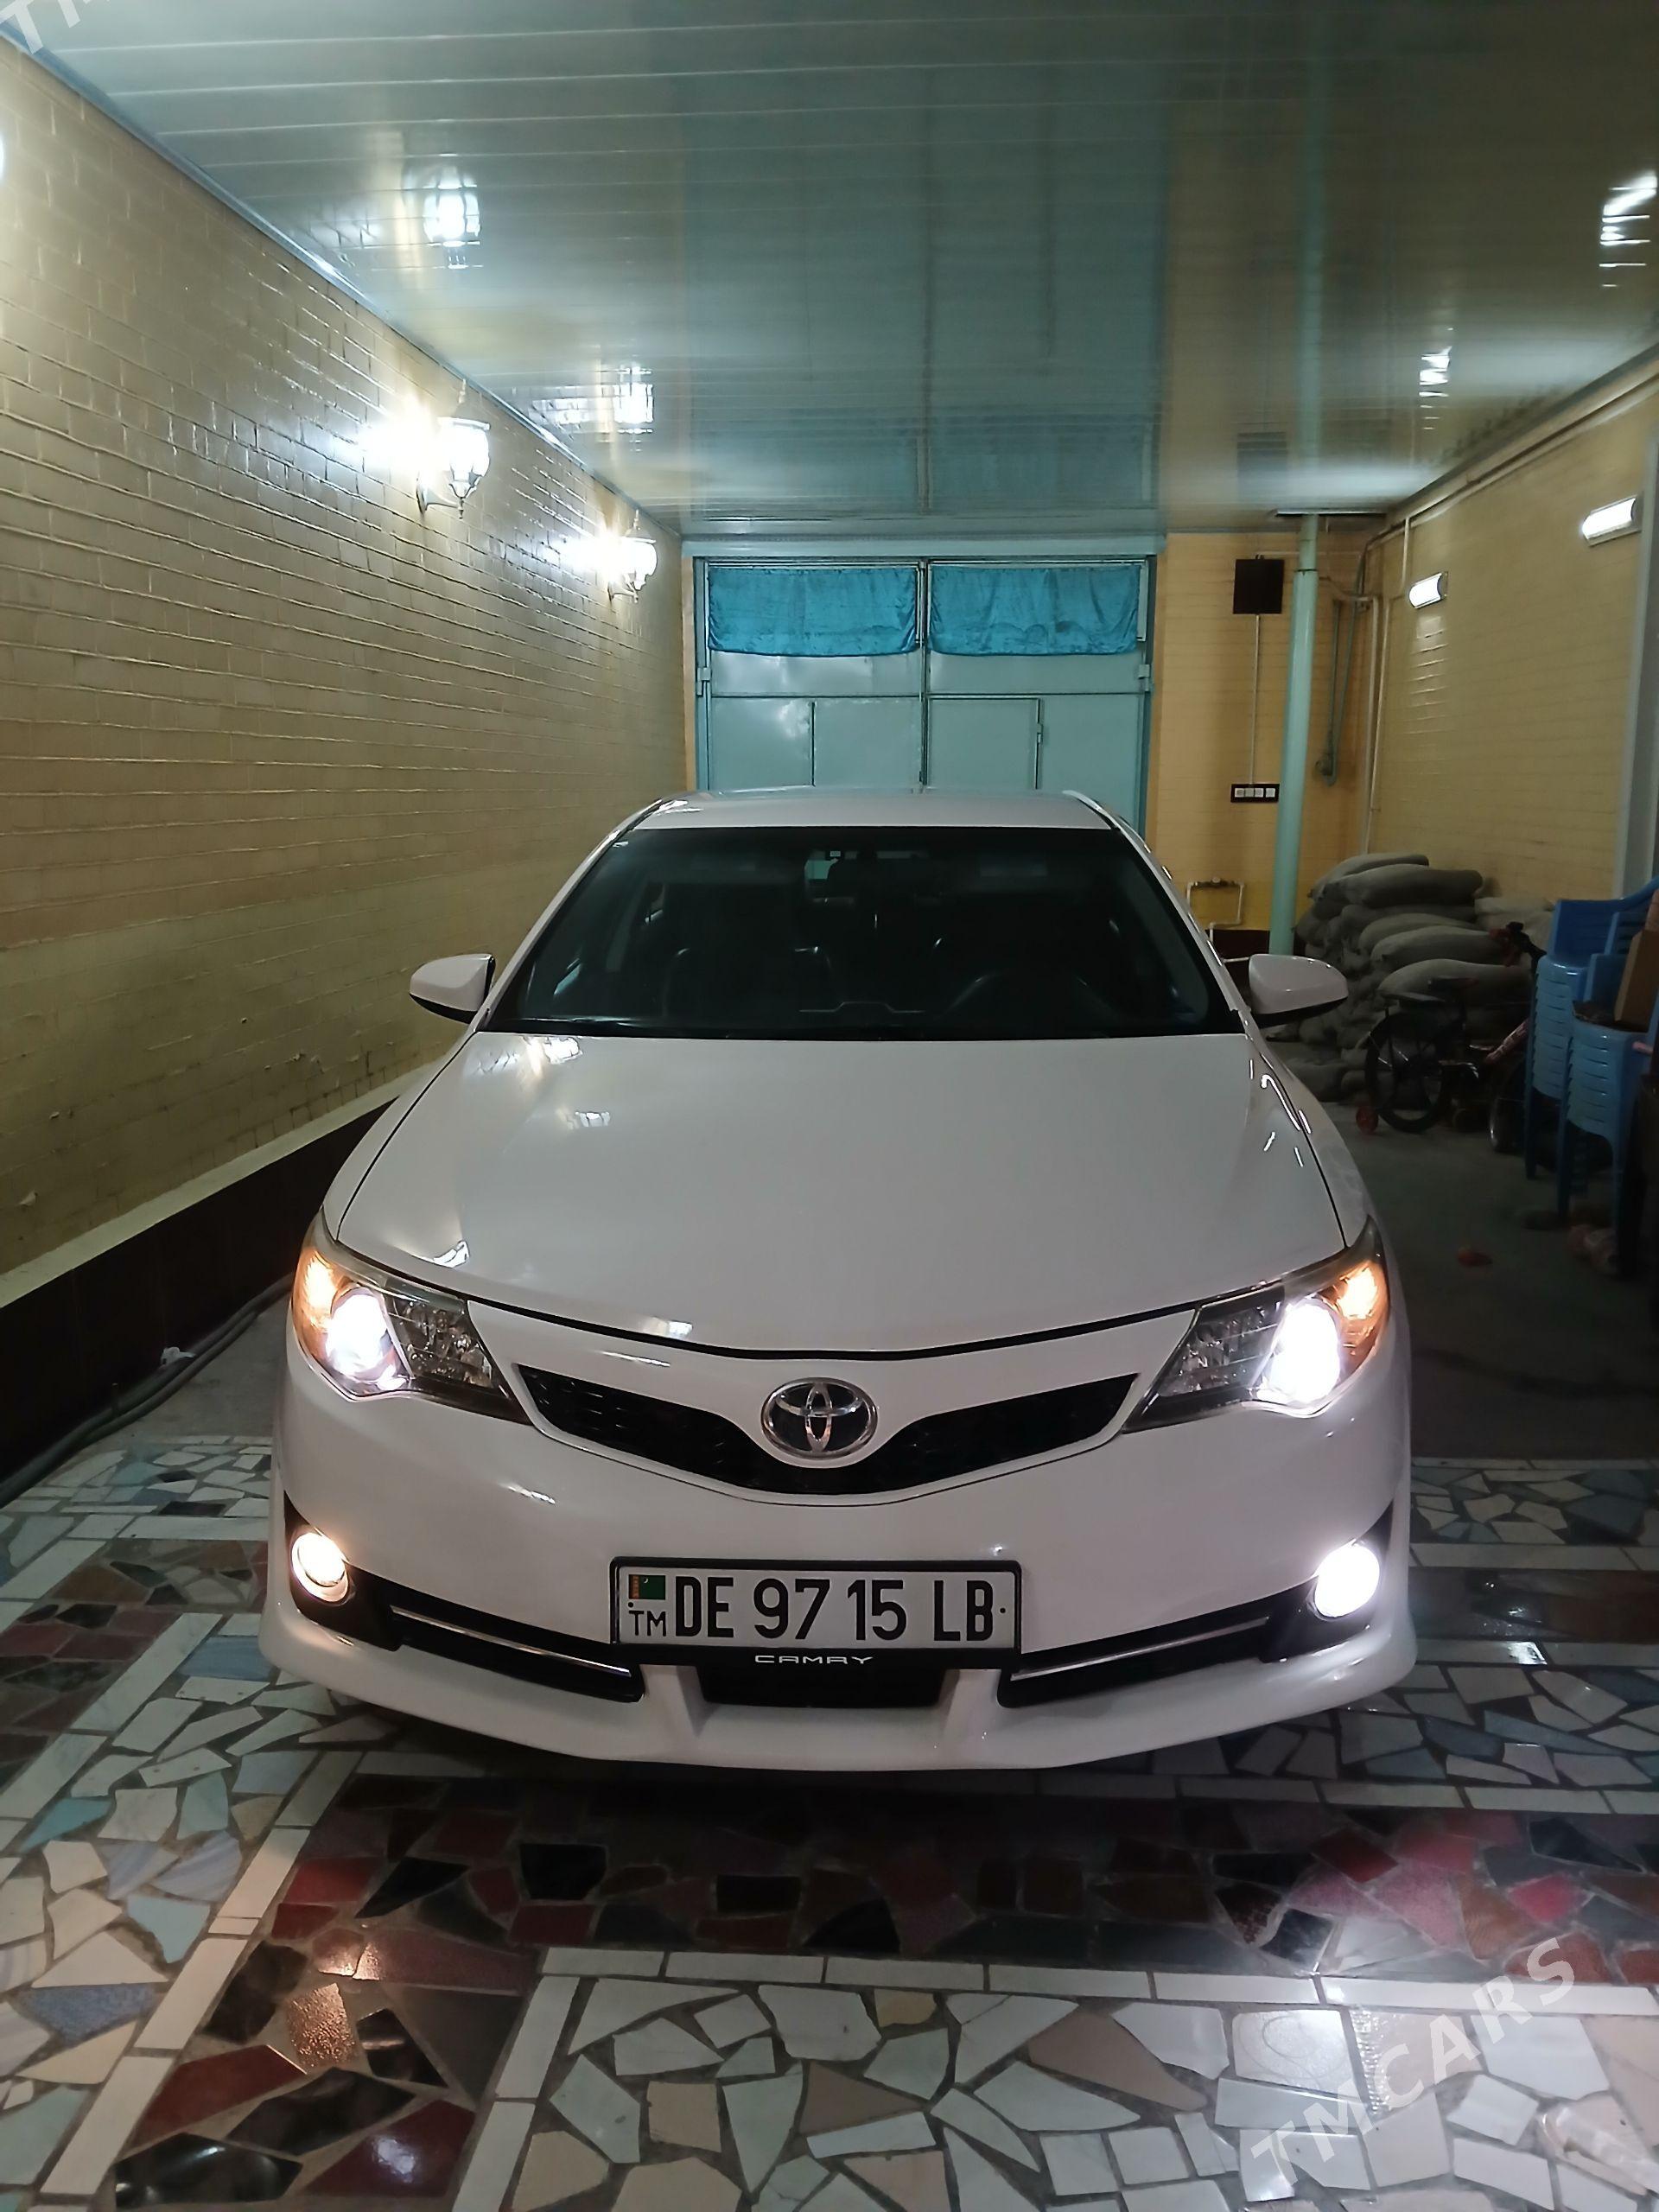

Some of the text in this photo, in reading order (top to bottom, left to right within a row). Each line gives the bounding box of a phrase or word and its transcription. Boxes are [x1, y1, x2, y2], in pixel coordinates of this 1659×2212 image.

[675, 1575, 995, 1643] DE 97 15 LB
[628, 1610, 667, 1637] TM
[754, 1655, 874, 1665] CAMRY
